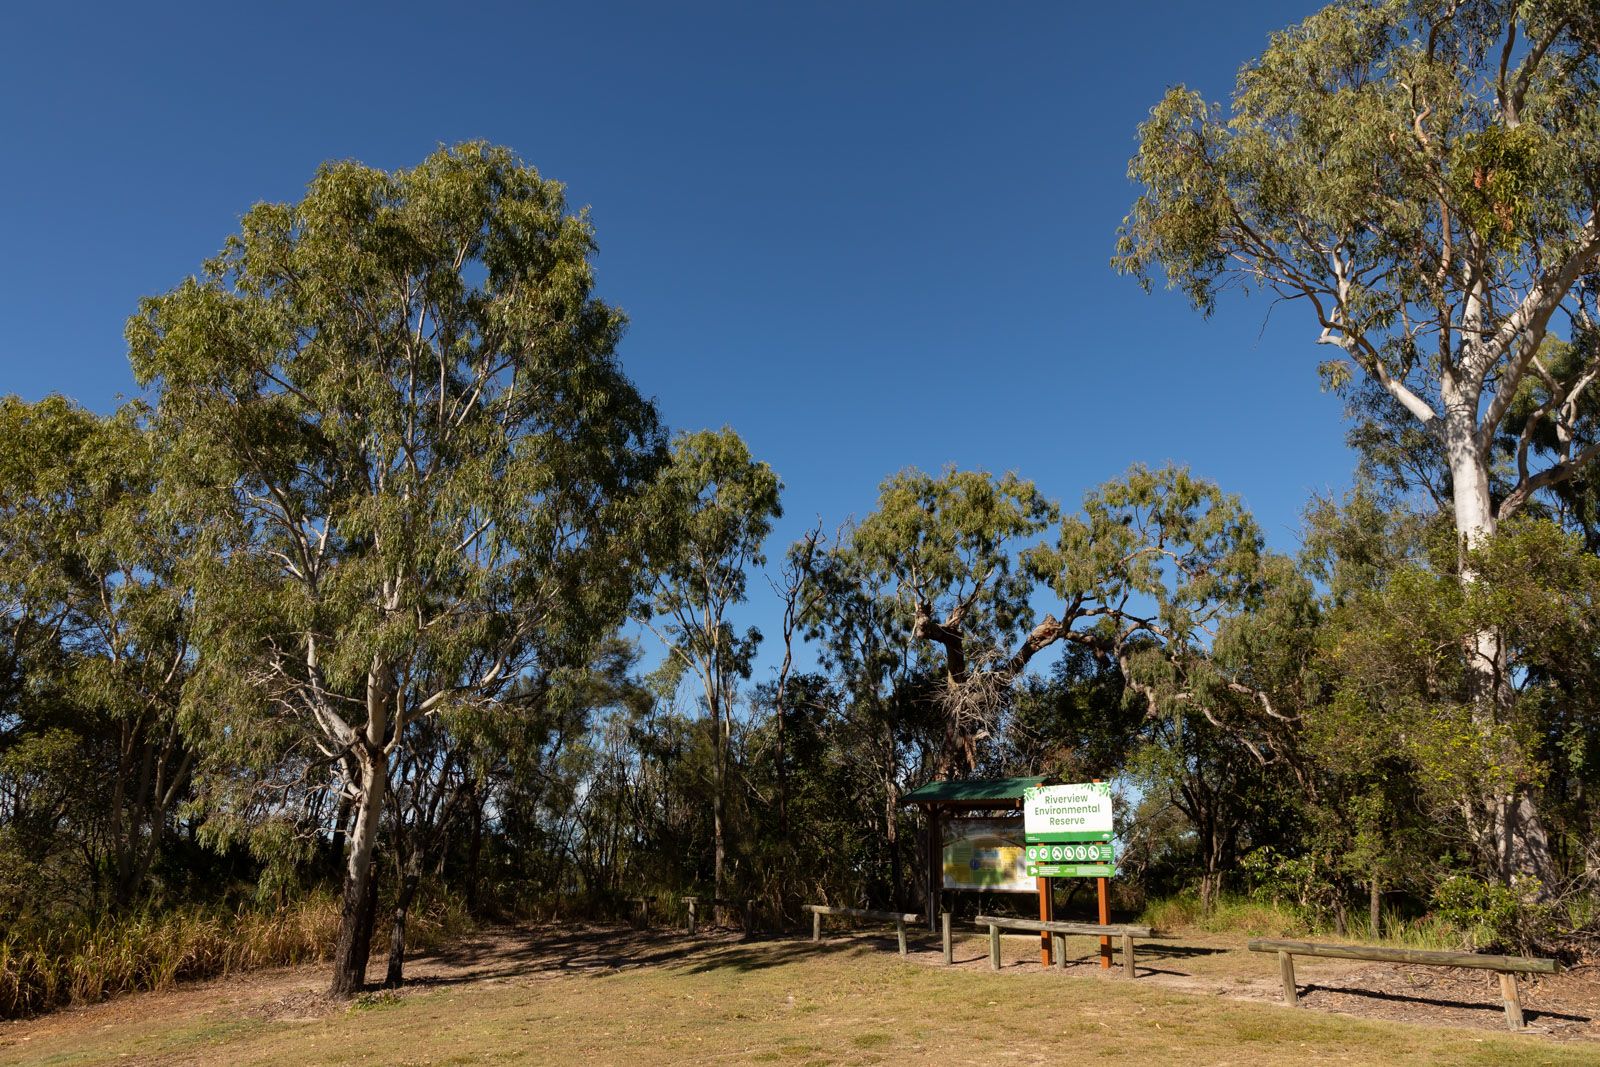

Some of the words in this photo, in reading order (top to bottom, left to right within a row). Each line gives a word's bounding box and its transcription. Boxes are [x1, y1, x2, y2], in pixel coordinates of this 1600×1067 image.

[1045, 793, 1088, 804] Riverview
[1035, 804, 1100, 815] Environmental
[1050, 817, 1085, 825] Reserve
